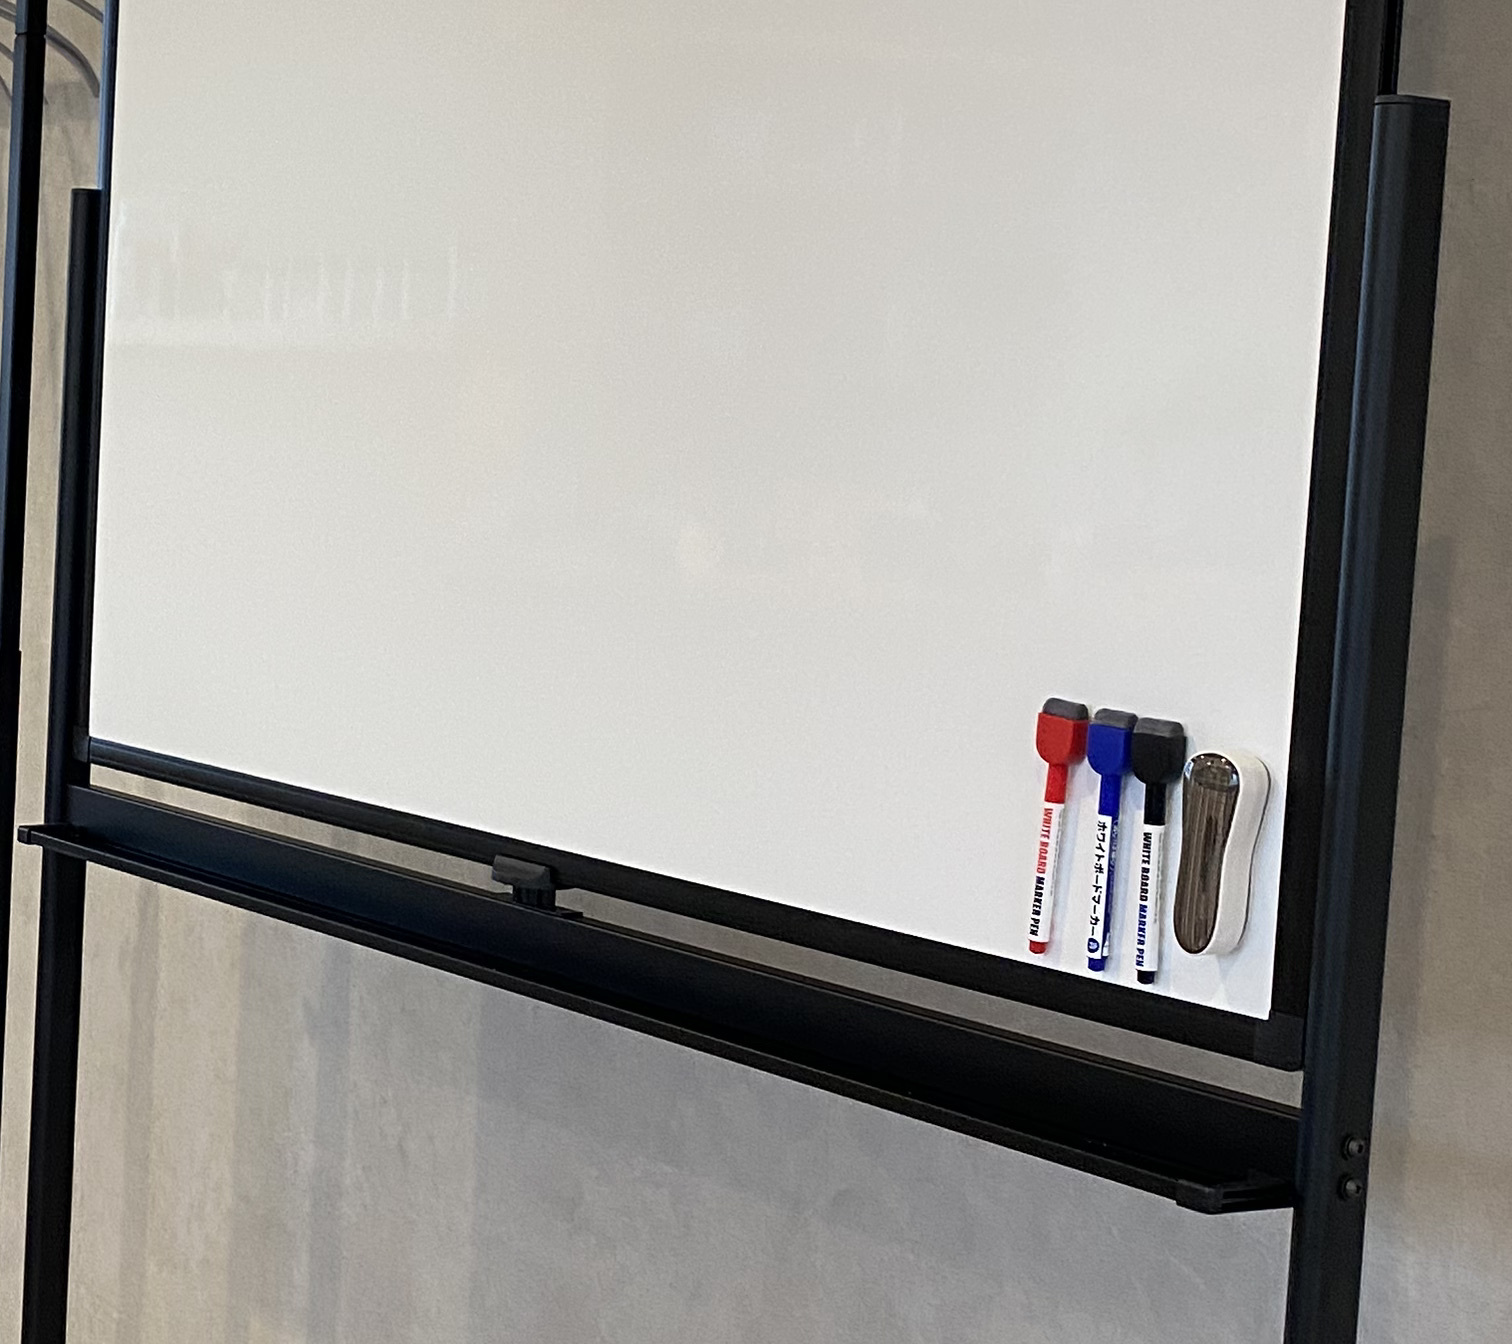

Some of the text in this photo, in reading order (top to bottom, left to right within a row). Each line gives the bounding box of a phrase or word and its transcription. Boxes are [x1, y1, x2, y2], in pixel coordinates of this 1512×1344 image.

[1029, 808, 1053, 936] WHITE BOARD MARKER PEN
[1090, 821, 1107, 936] ホワイトボードマーカー
[1135, 832, 1152, 967] WHITE BOARD MARKER PEN
